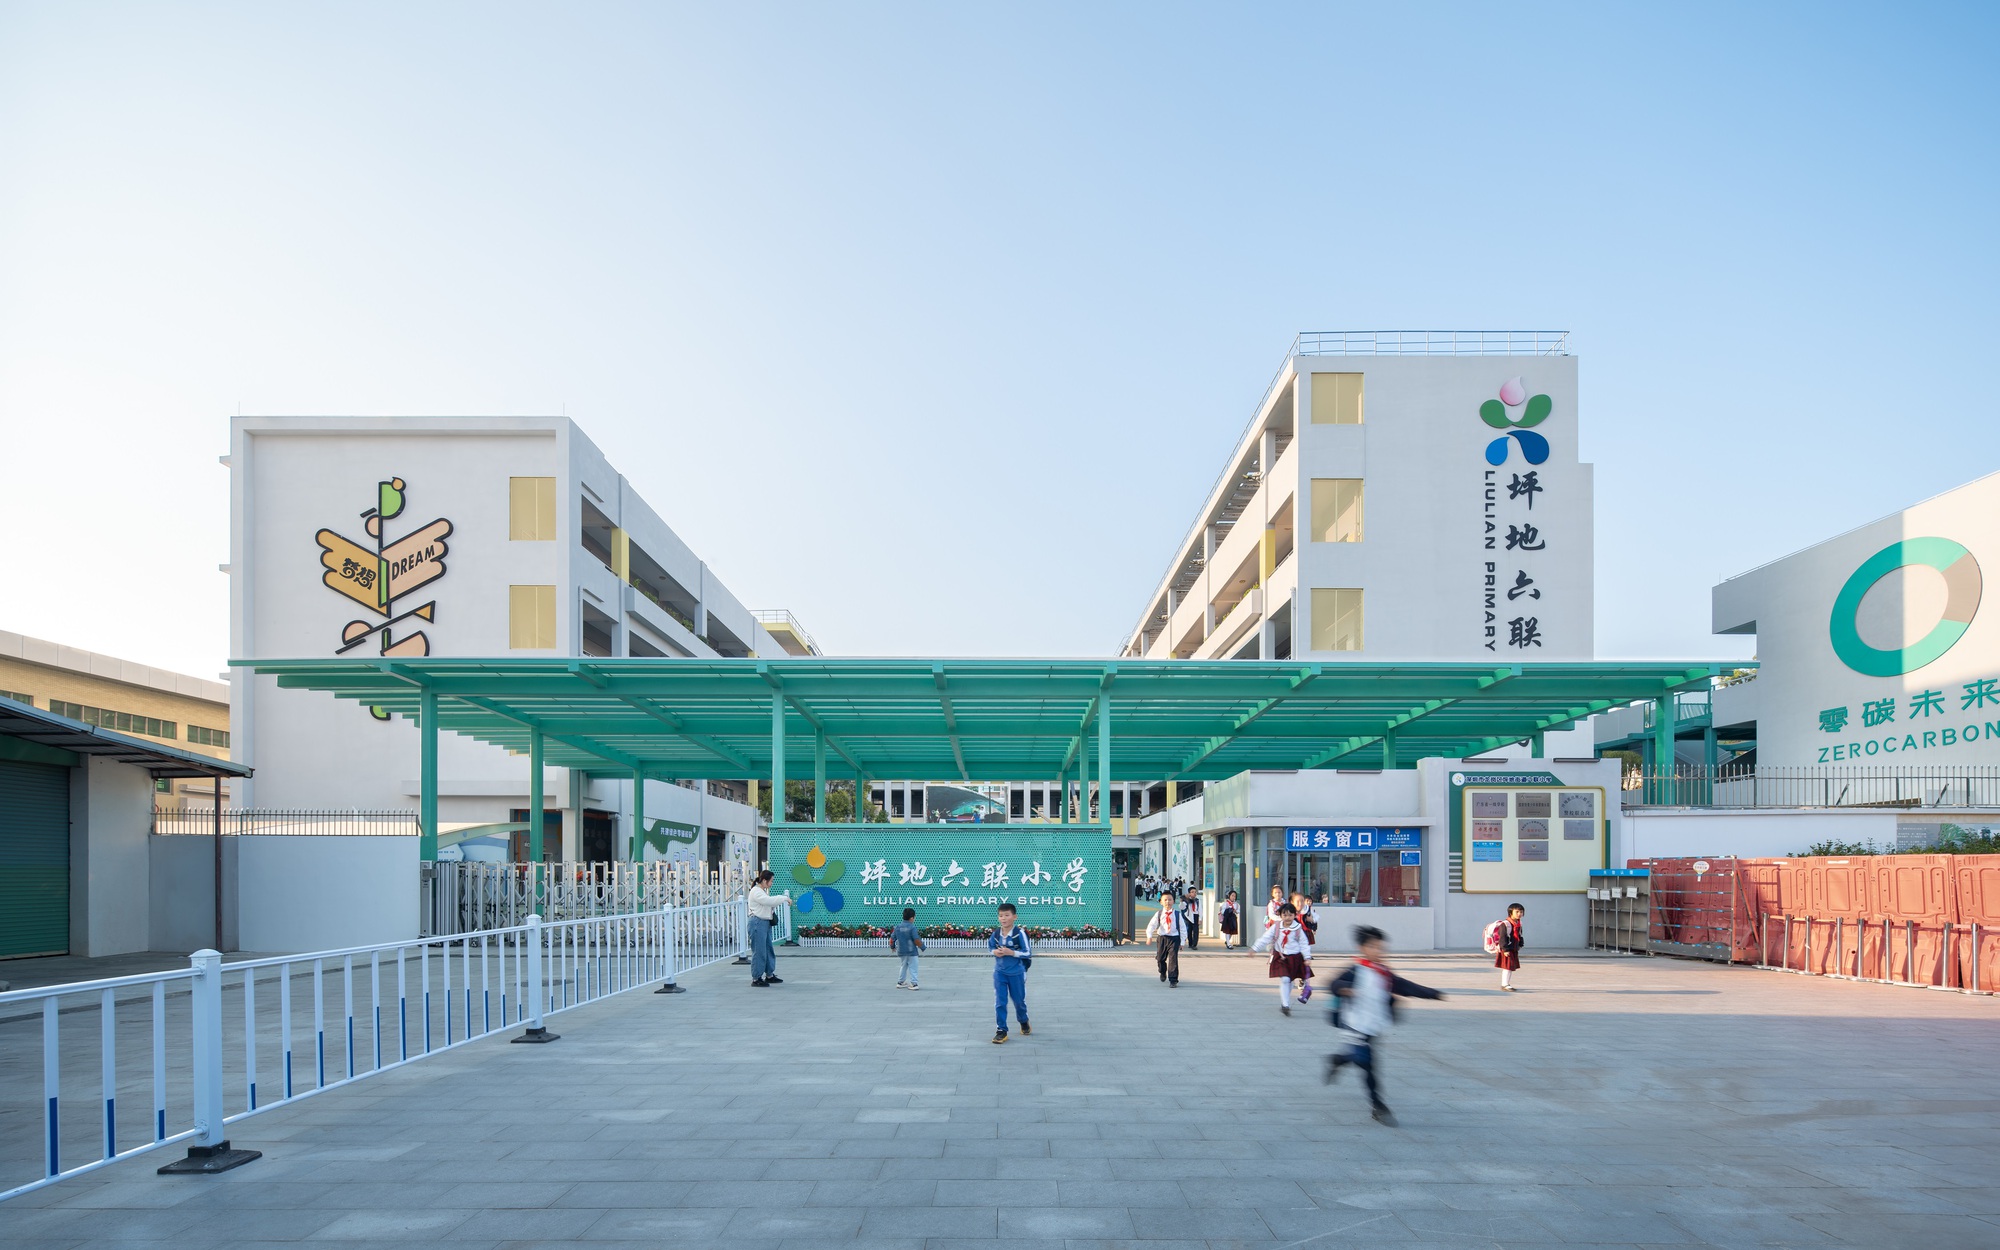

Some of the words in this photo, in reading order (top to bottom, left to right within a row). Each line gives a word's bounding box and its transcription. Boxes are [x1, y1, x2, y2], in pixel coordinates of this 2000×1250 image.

[1485, 470, 1496, 549] LIULIAN
[339, 557, 377, 590] 梦想
[391, 545, 435, 581] DREAM
[1505, 470, 1546, 649] 坪地六联
[1485, 562, 1496, 651] PRIMARY
[1818, 678, 2000, 733] 零碳未来
[1818, 721, 2000, 763] ZEROCARBON
[1292, 830, 1372, 848] 服务窗口
[859, 857, 1089, 893] 坪地六联小学
[863, 896, 928, 906] LIULIAN
[936, 896, 1009, 906] PRIMARY
[1017, 896, 1087, 906] SCHOOL
